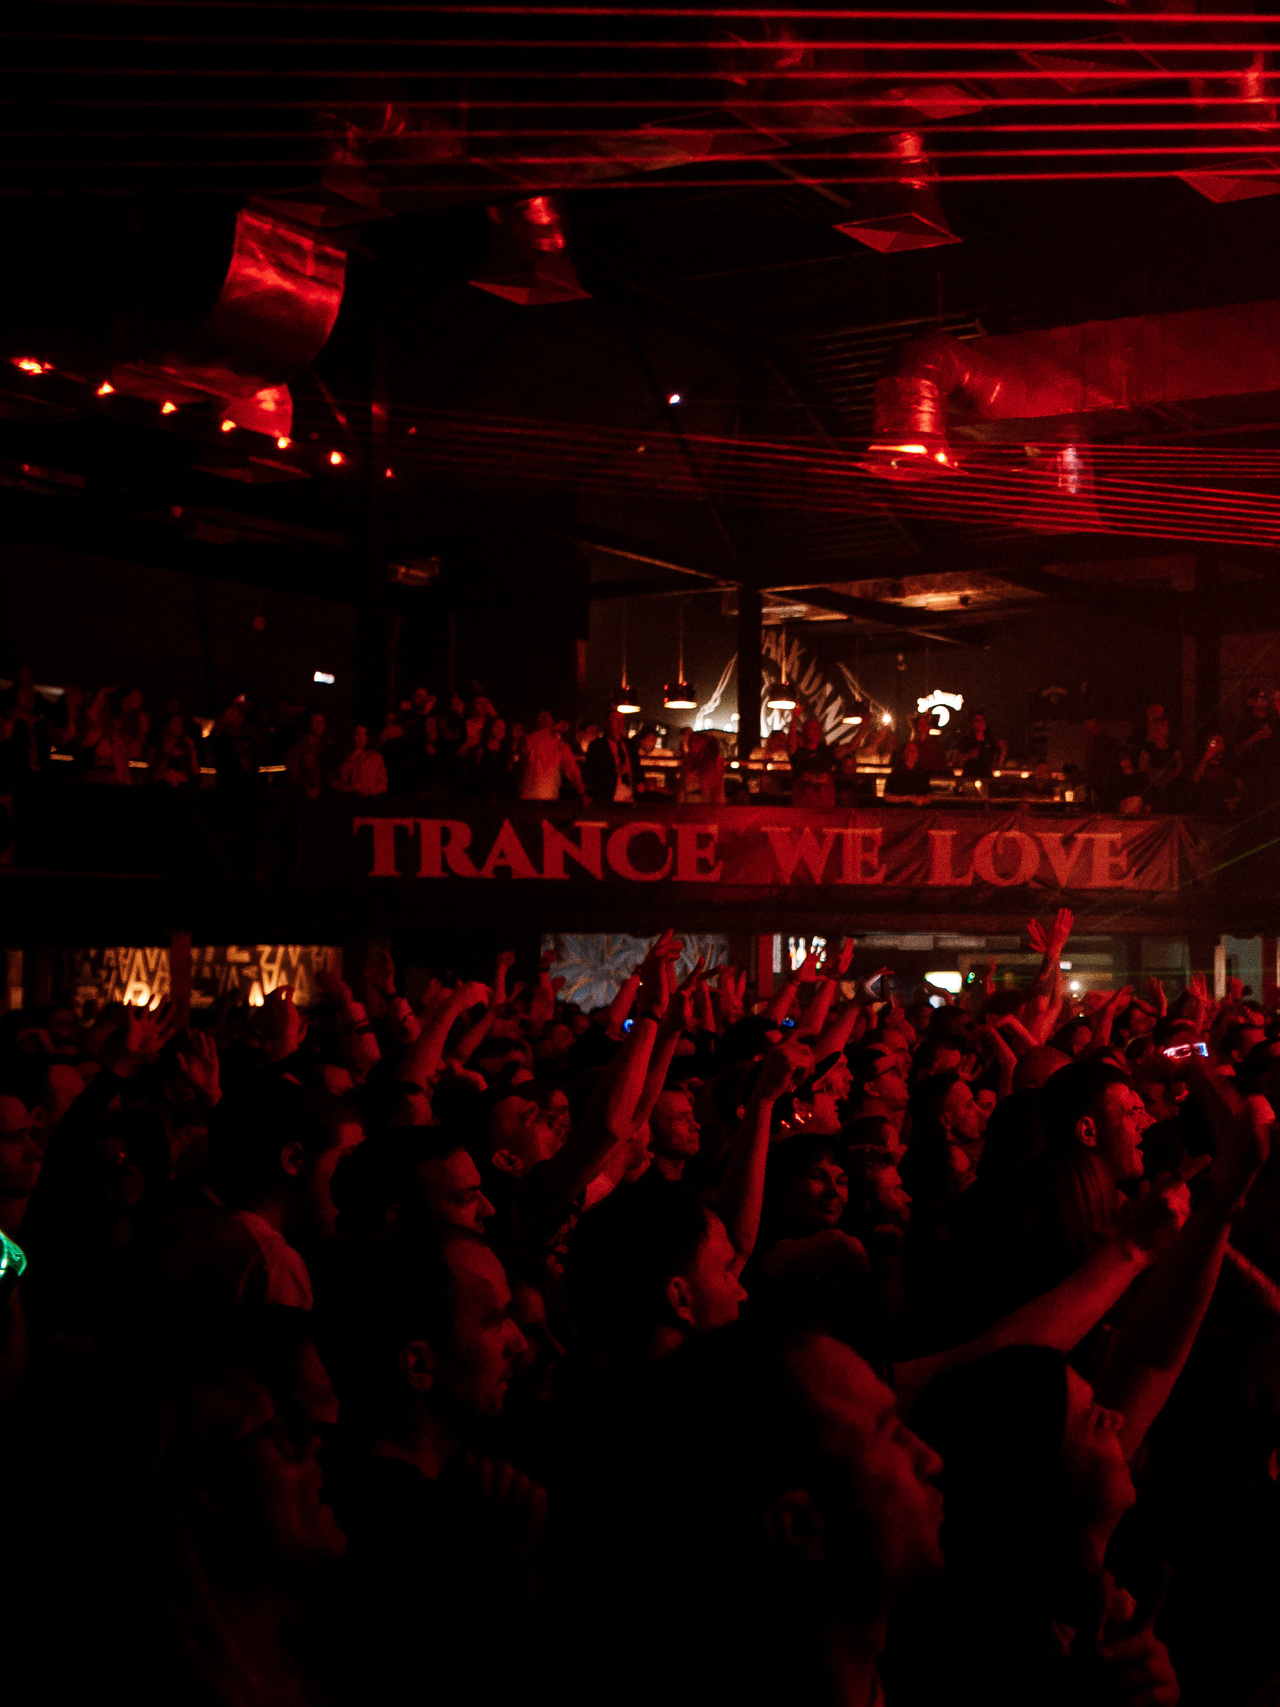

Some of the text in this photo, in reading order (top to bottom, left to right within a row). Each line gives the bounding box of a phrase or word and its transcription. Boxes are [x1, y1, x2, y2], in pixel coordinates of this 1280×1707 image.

[353, 816, 1138, 890] TRANCE WE LOVE
